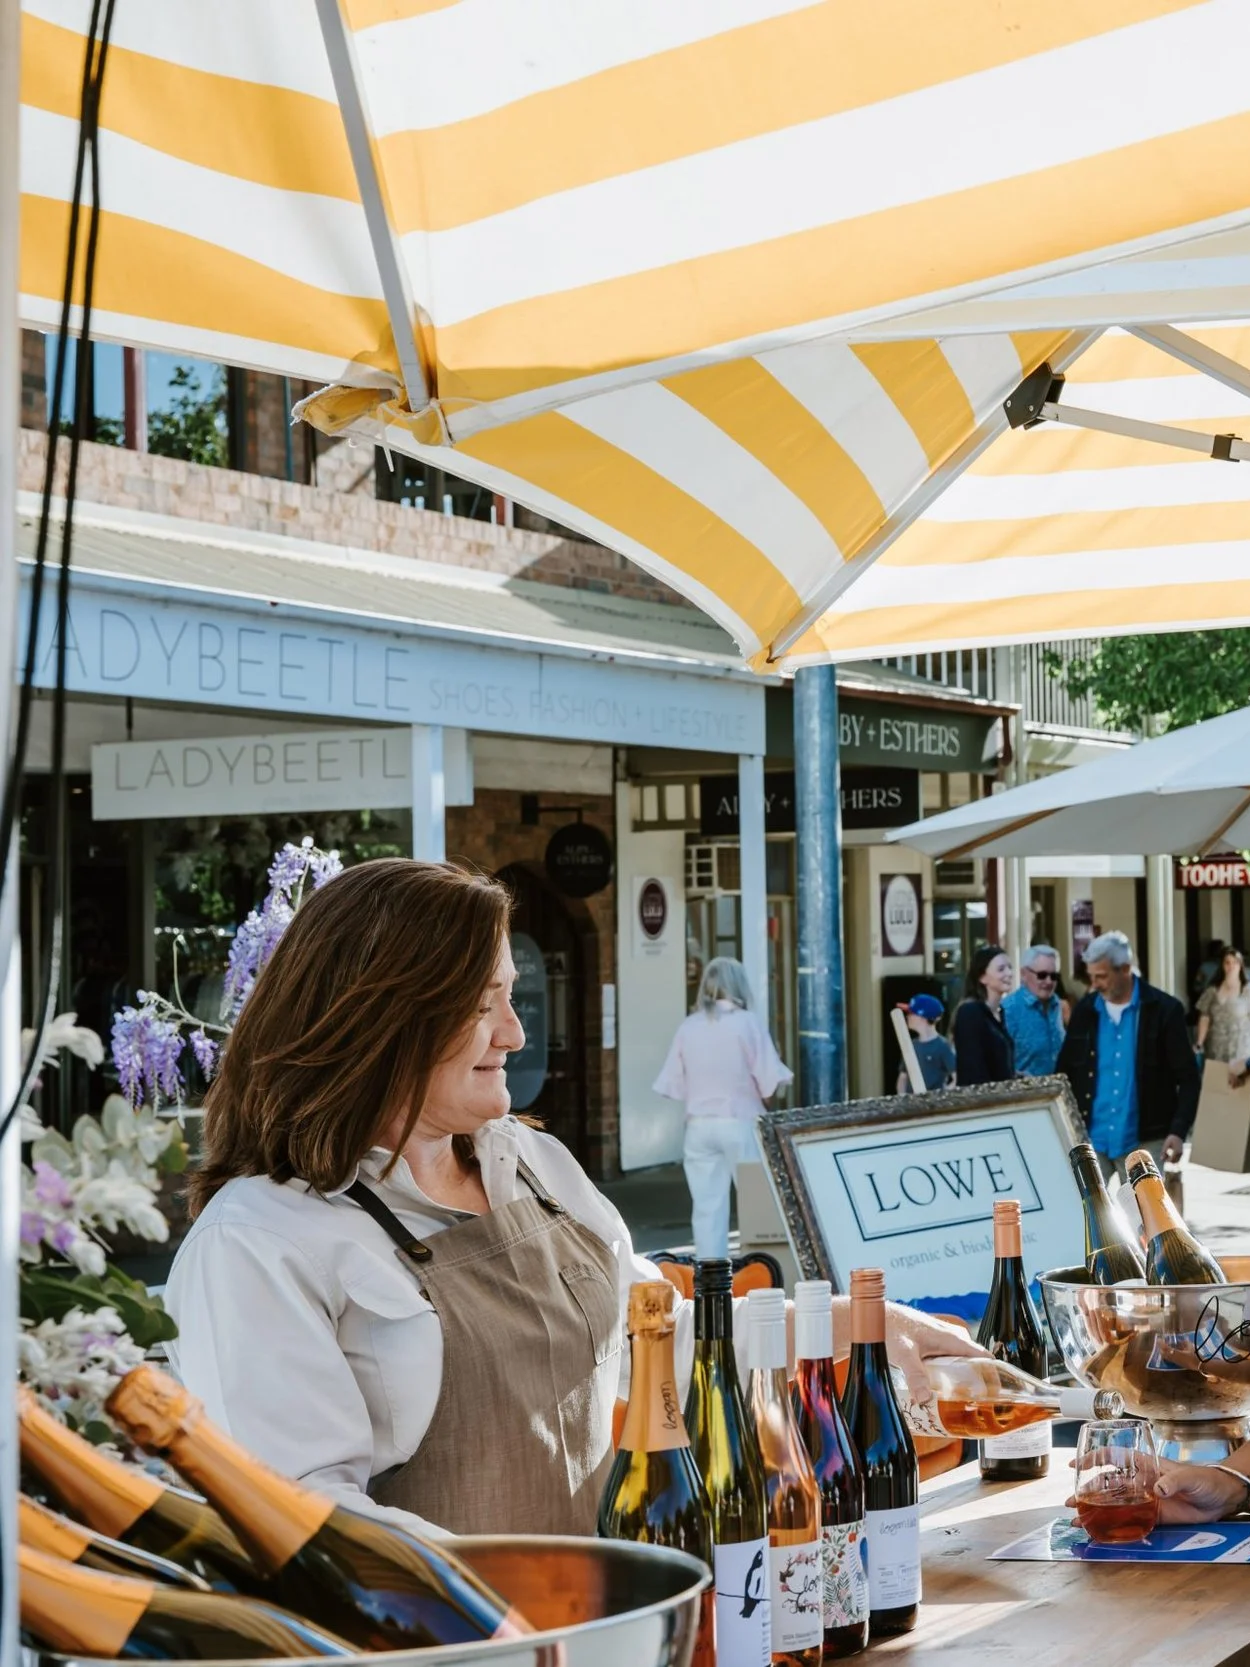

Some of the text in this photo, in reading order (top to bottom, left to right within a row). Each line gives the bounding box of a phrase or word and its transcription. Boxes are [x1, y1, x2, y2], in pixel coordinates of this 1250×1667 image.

[17, 598, 411, 711] ADYBEETLE
[429, 679, 518, 721] SHOES,
[529, 689, 627, 729] FASHION
[651, 705, 746, 742] LIFESTYLE
[879, 718, 961, 757] ESTHERS
[115, 738, 407, 791] LADYBEETL
[864, 1153, 1014, 1213] LOWE
[890, 1247, 941, 1269] organic
[943, 1242, 960, 1257] &
